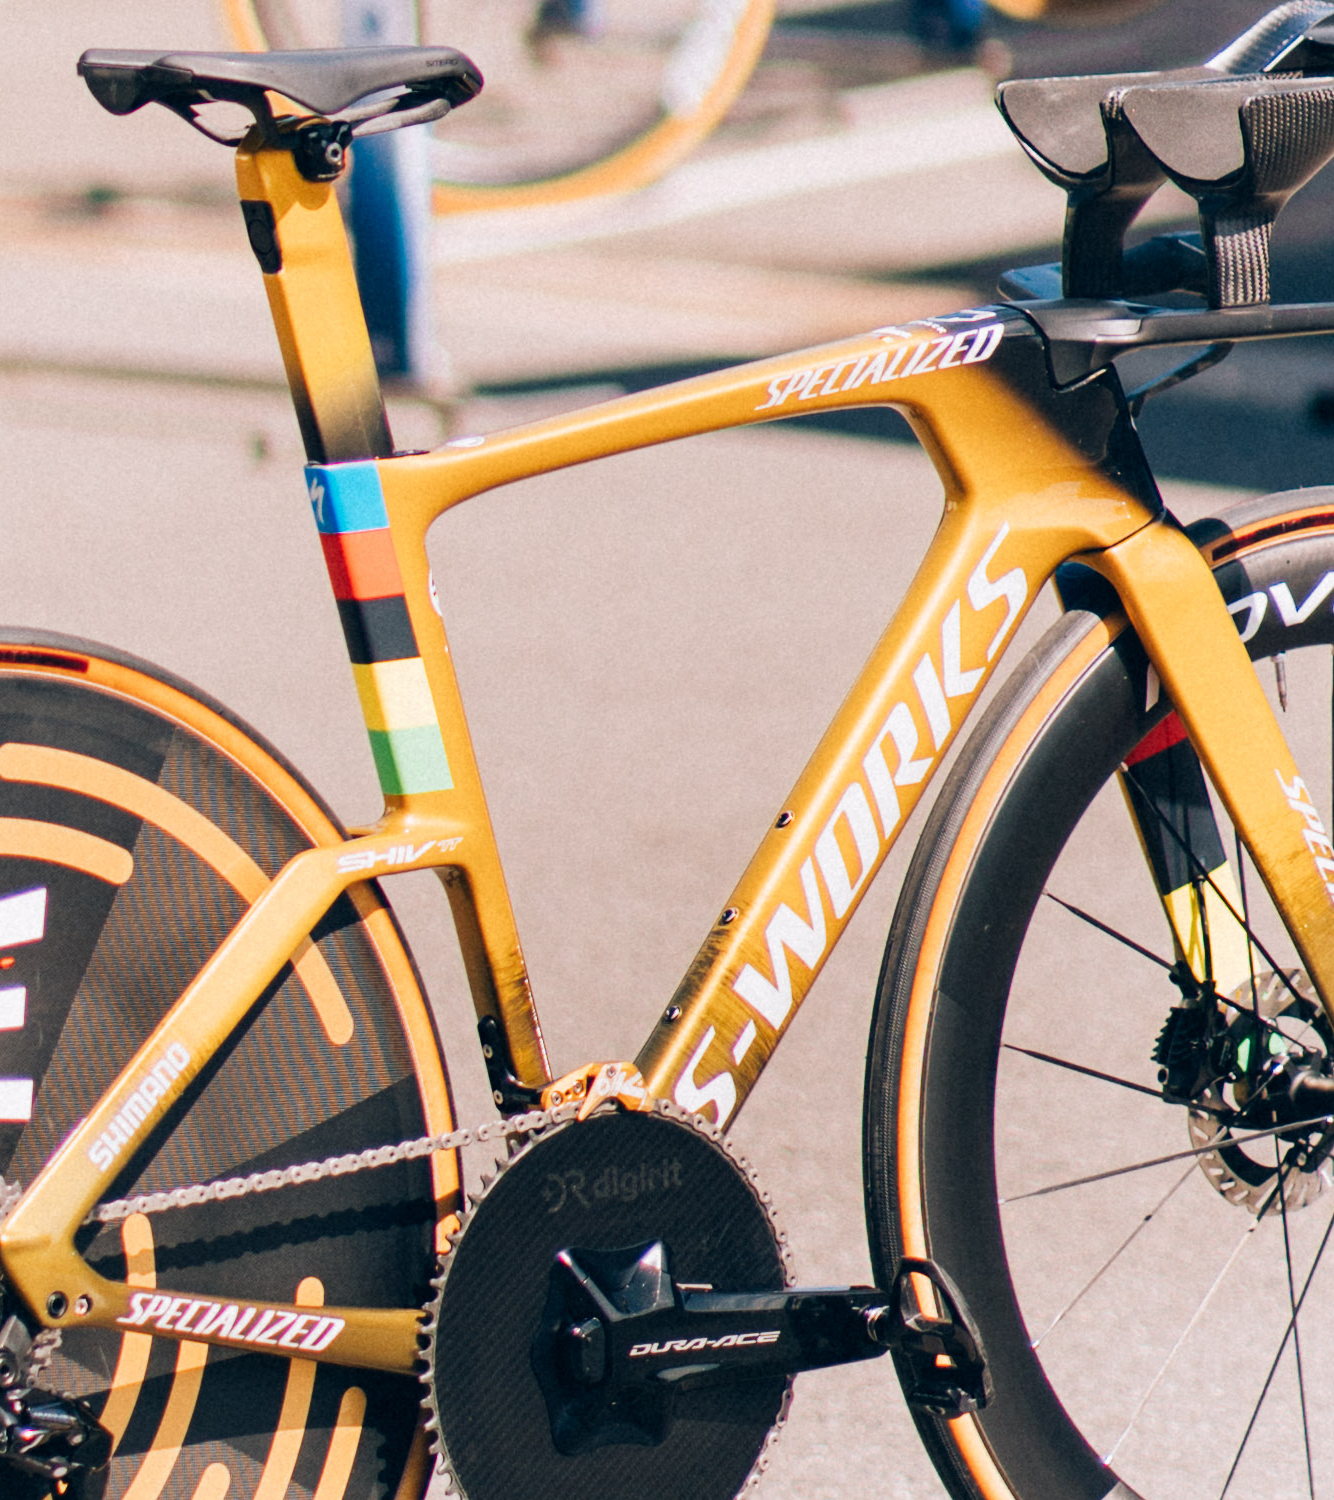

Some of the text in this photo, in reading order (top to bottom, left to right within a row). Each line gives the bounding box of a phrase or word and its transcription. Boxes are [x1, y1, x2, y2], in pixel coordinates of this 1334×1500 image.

[754, 322, 1005, 411] SPECIALIZED
[337, 840, 436, 874] SHIV
[674, 523, 1028, 1131] S-WORKS
[87, 1042, 192, 1173] SHIMANO
[117, 1292, 347, 1352] SPECIALIZED
[628, 1330, 782, 1357] DURA-ACE
